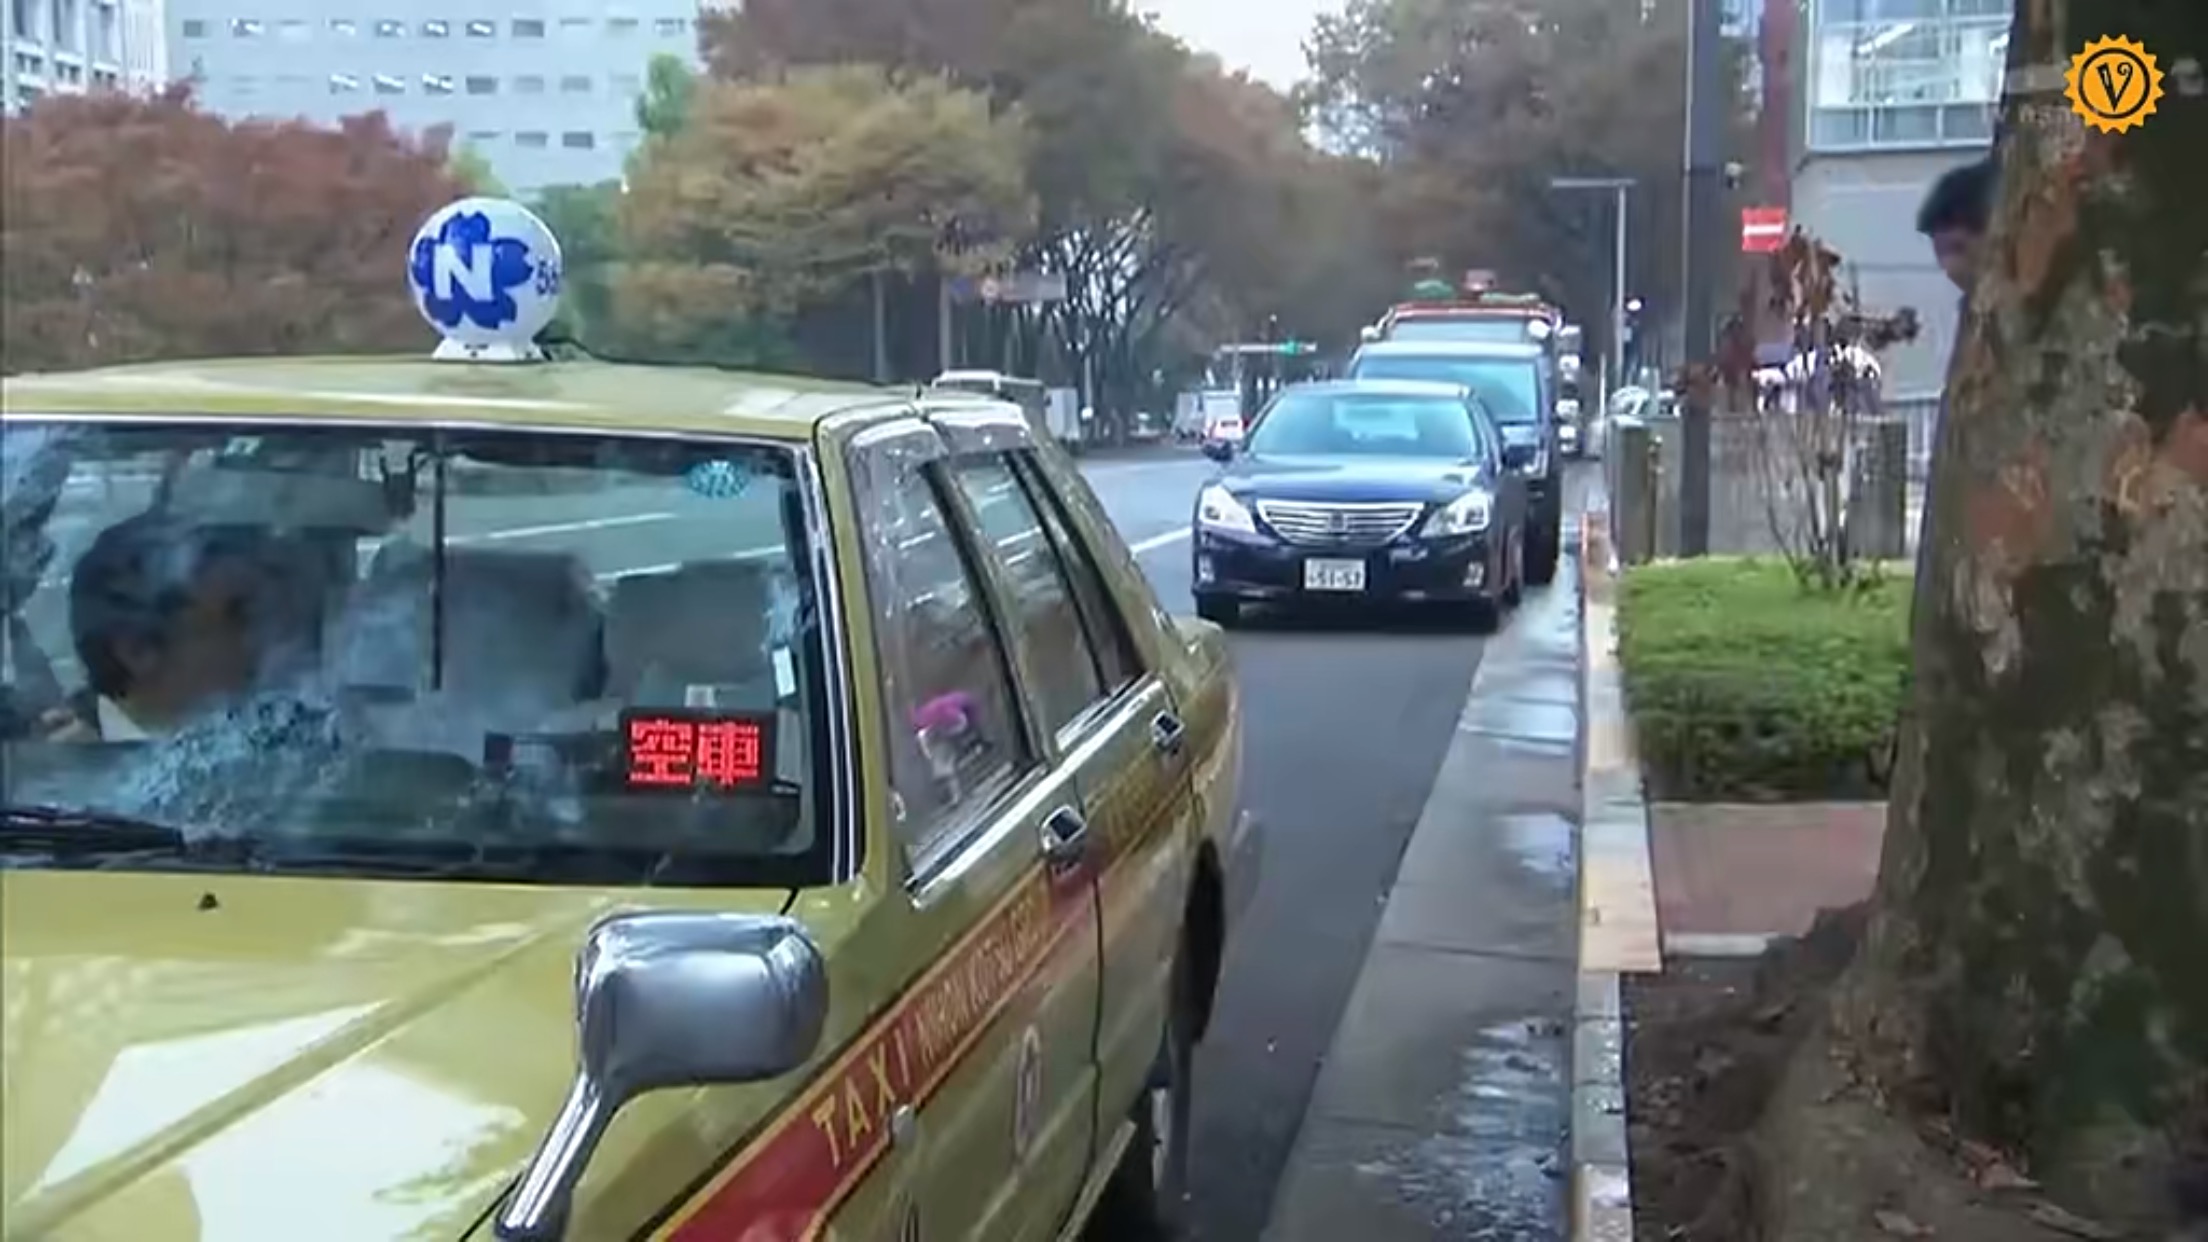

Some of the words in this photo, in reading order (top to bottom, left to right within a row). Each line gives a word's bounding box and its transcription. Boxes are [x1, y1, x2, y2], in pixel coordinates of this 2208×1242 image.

[434, 243, 494, 301] N
[631, 719, 759, 785] 空車
[811, 1028, 910, 1169] TAXI
